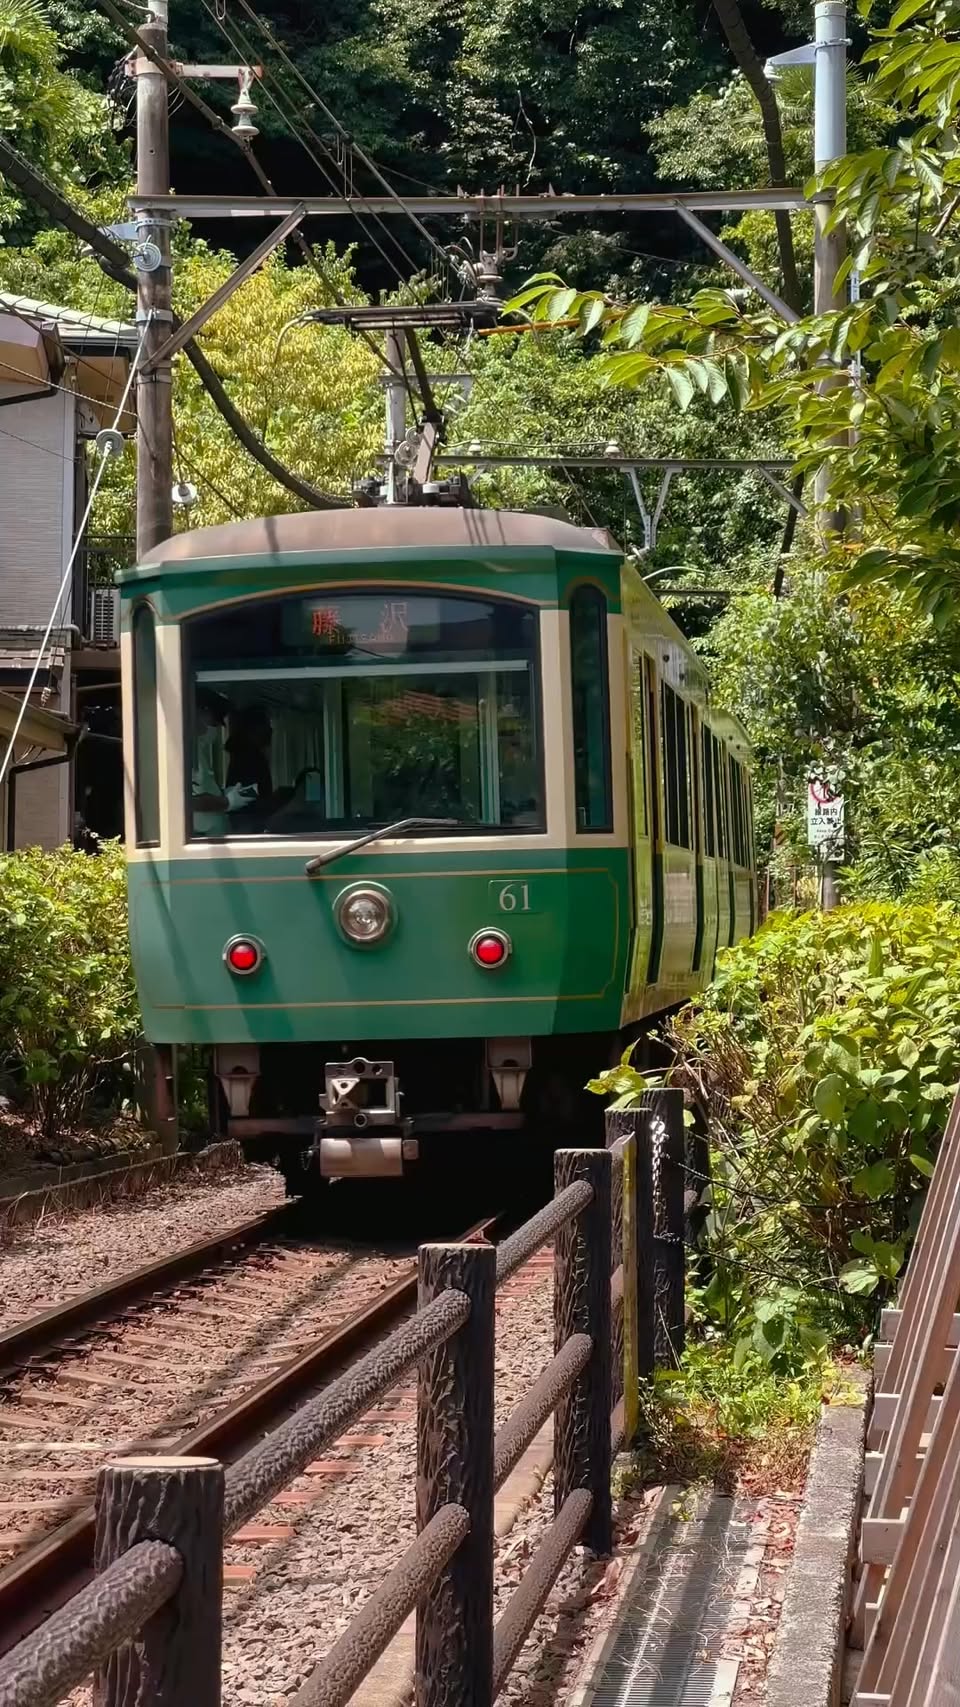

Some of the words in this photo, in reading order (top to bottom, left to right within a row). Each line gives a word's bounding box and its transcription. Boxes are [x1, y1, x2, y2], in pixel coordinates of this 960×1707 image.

[815, 808, 838, 816] 線路内
[499, 884, 532, 911] 61
